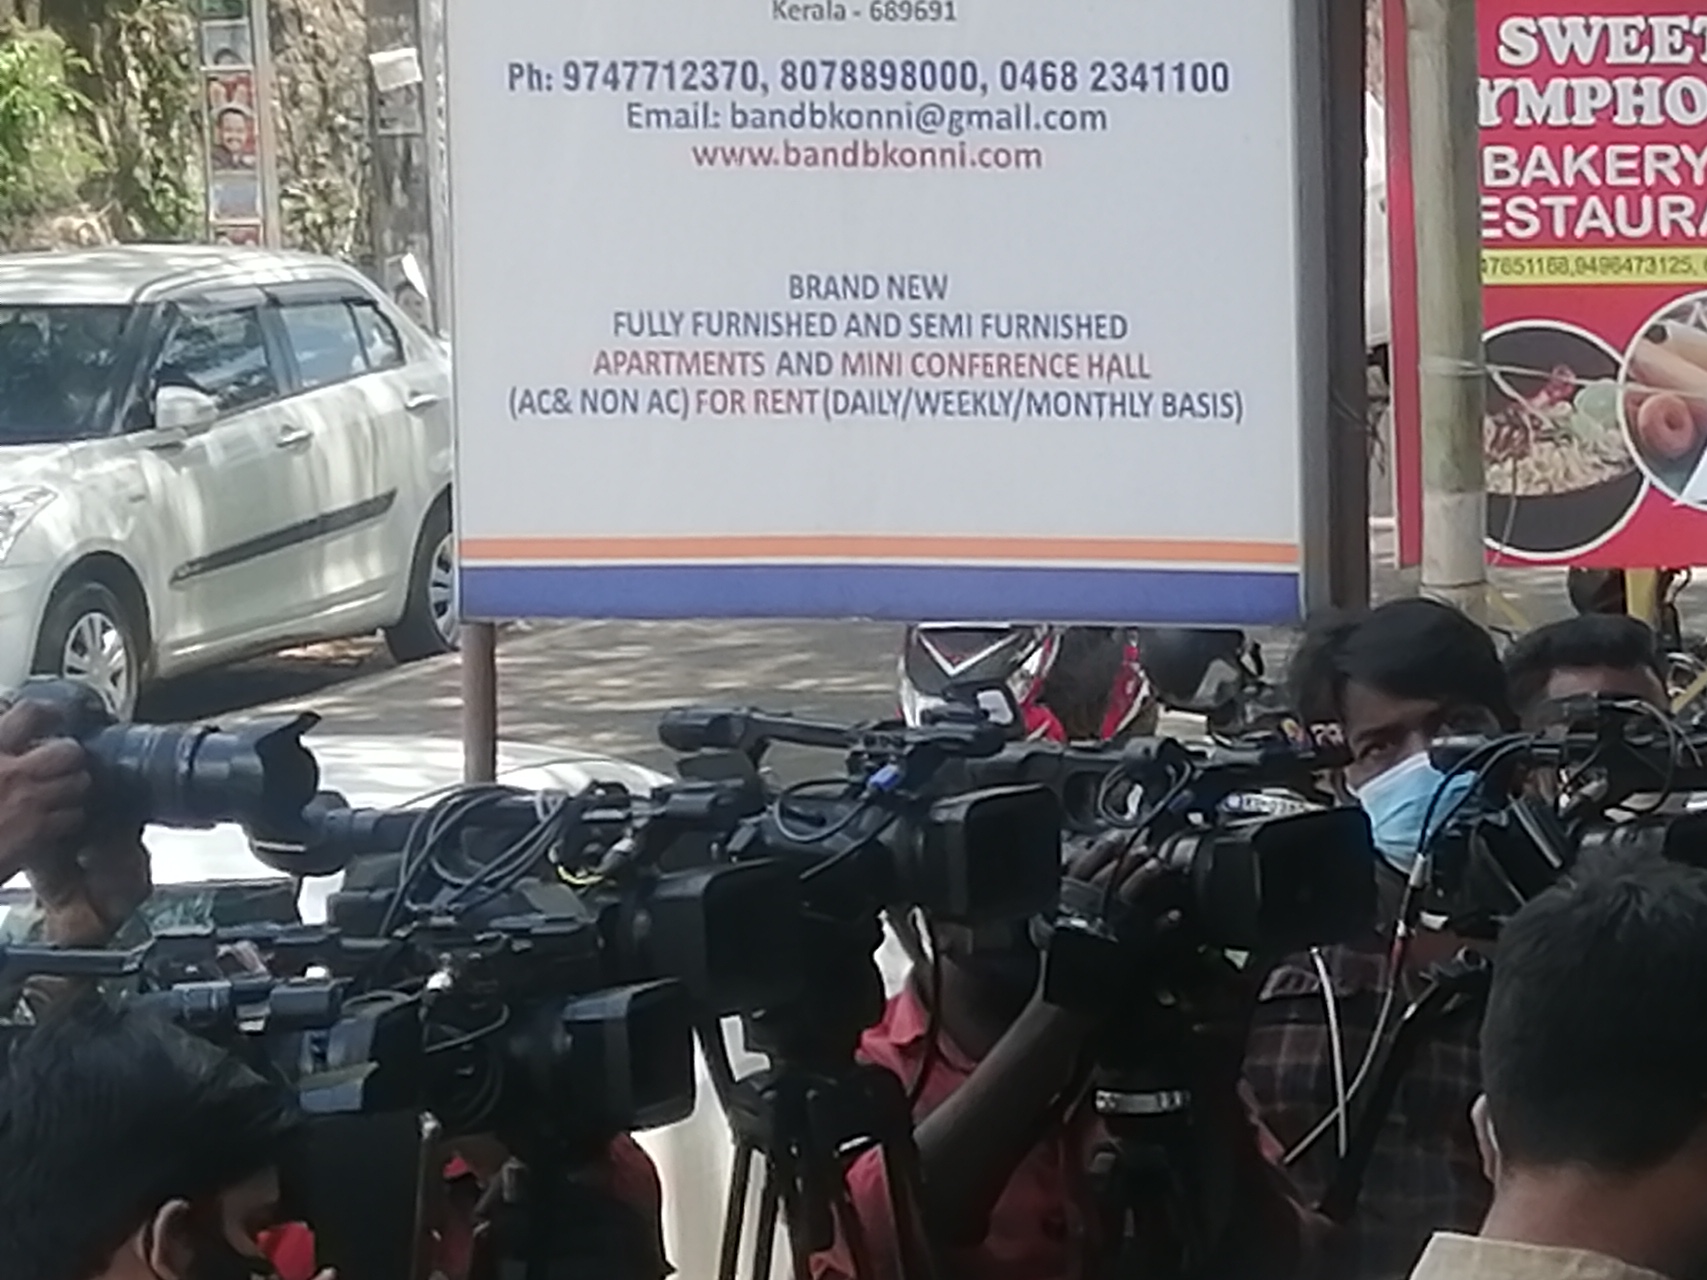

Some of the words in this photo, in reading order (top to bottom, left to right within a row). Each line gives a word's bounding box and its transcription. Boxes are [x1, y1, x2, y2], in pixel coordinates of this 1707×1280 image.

[772, 0, 847, 21] Kerala
[869, 0, 957, 22] 689691
[508, 62, 553, 92] Ph:
[563, 59, 770, 96] 9747712370,
[780, 59, 988, 96] 8078898000,
[999, 60, 1079, 93] 0468
[1089, 61, 1230, 94] 2341100
[626, 101, 721, 130] Email:
[730, 101, 1108, 137] bandbkonni@gmail.com
[691, 138, 1043, 169] www.bandbkonni.com
[788, 273, 880, 301] BRAND
[886, 274, 949, 301] NEW
[613, 310, 685, 338] FULLY
[692, 311, 837, 339] FURNISHED
[844, 312, 901, 339] AND
[909, 313, 973, 339] SEMI
[980, 314, 1128, 340] FURNISHED
[593, 349, 766, 378] APARTMENTS
[775, 350, 834, 378] AND
[841, 351, 902, 378] MINI
[910, 351, 1079, 380] CONFERENCE
[1087, 352, 1152, 383] HALL
[580, 388, 639, 415] NON
[646, 387, 689, 421] AC)
[696, 389, 746, 415] FOR
[1161, 391, 1244, 425] BASIS)
